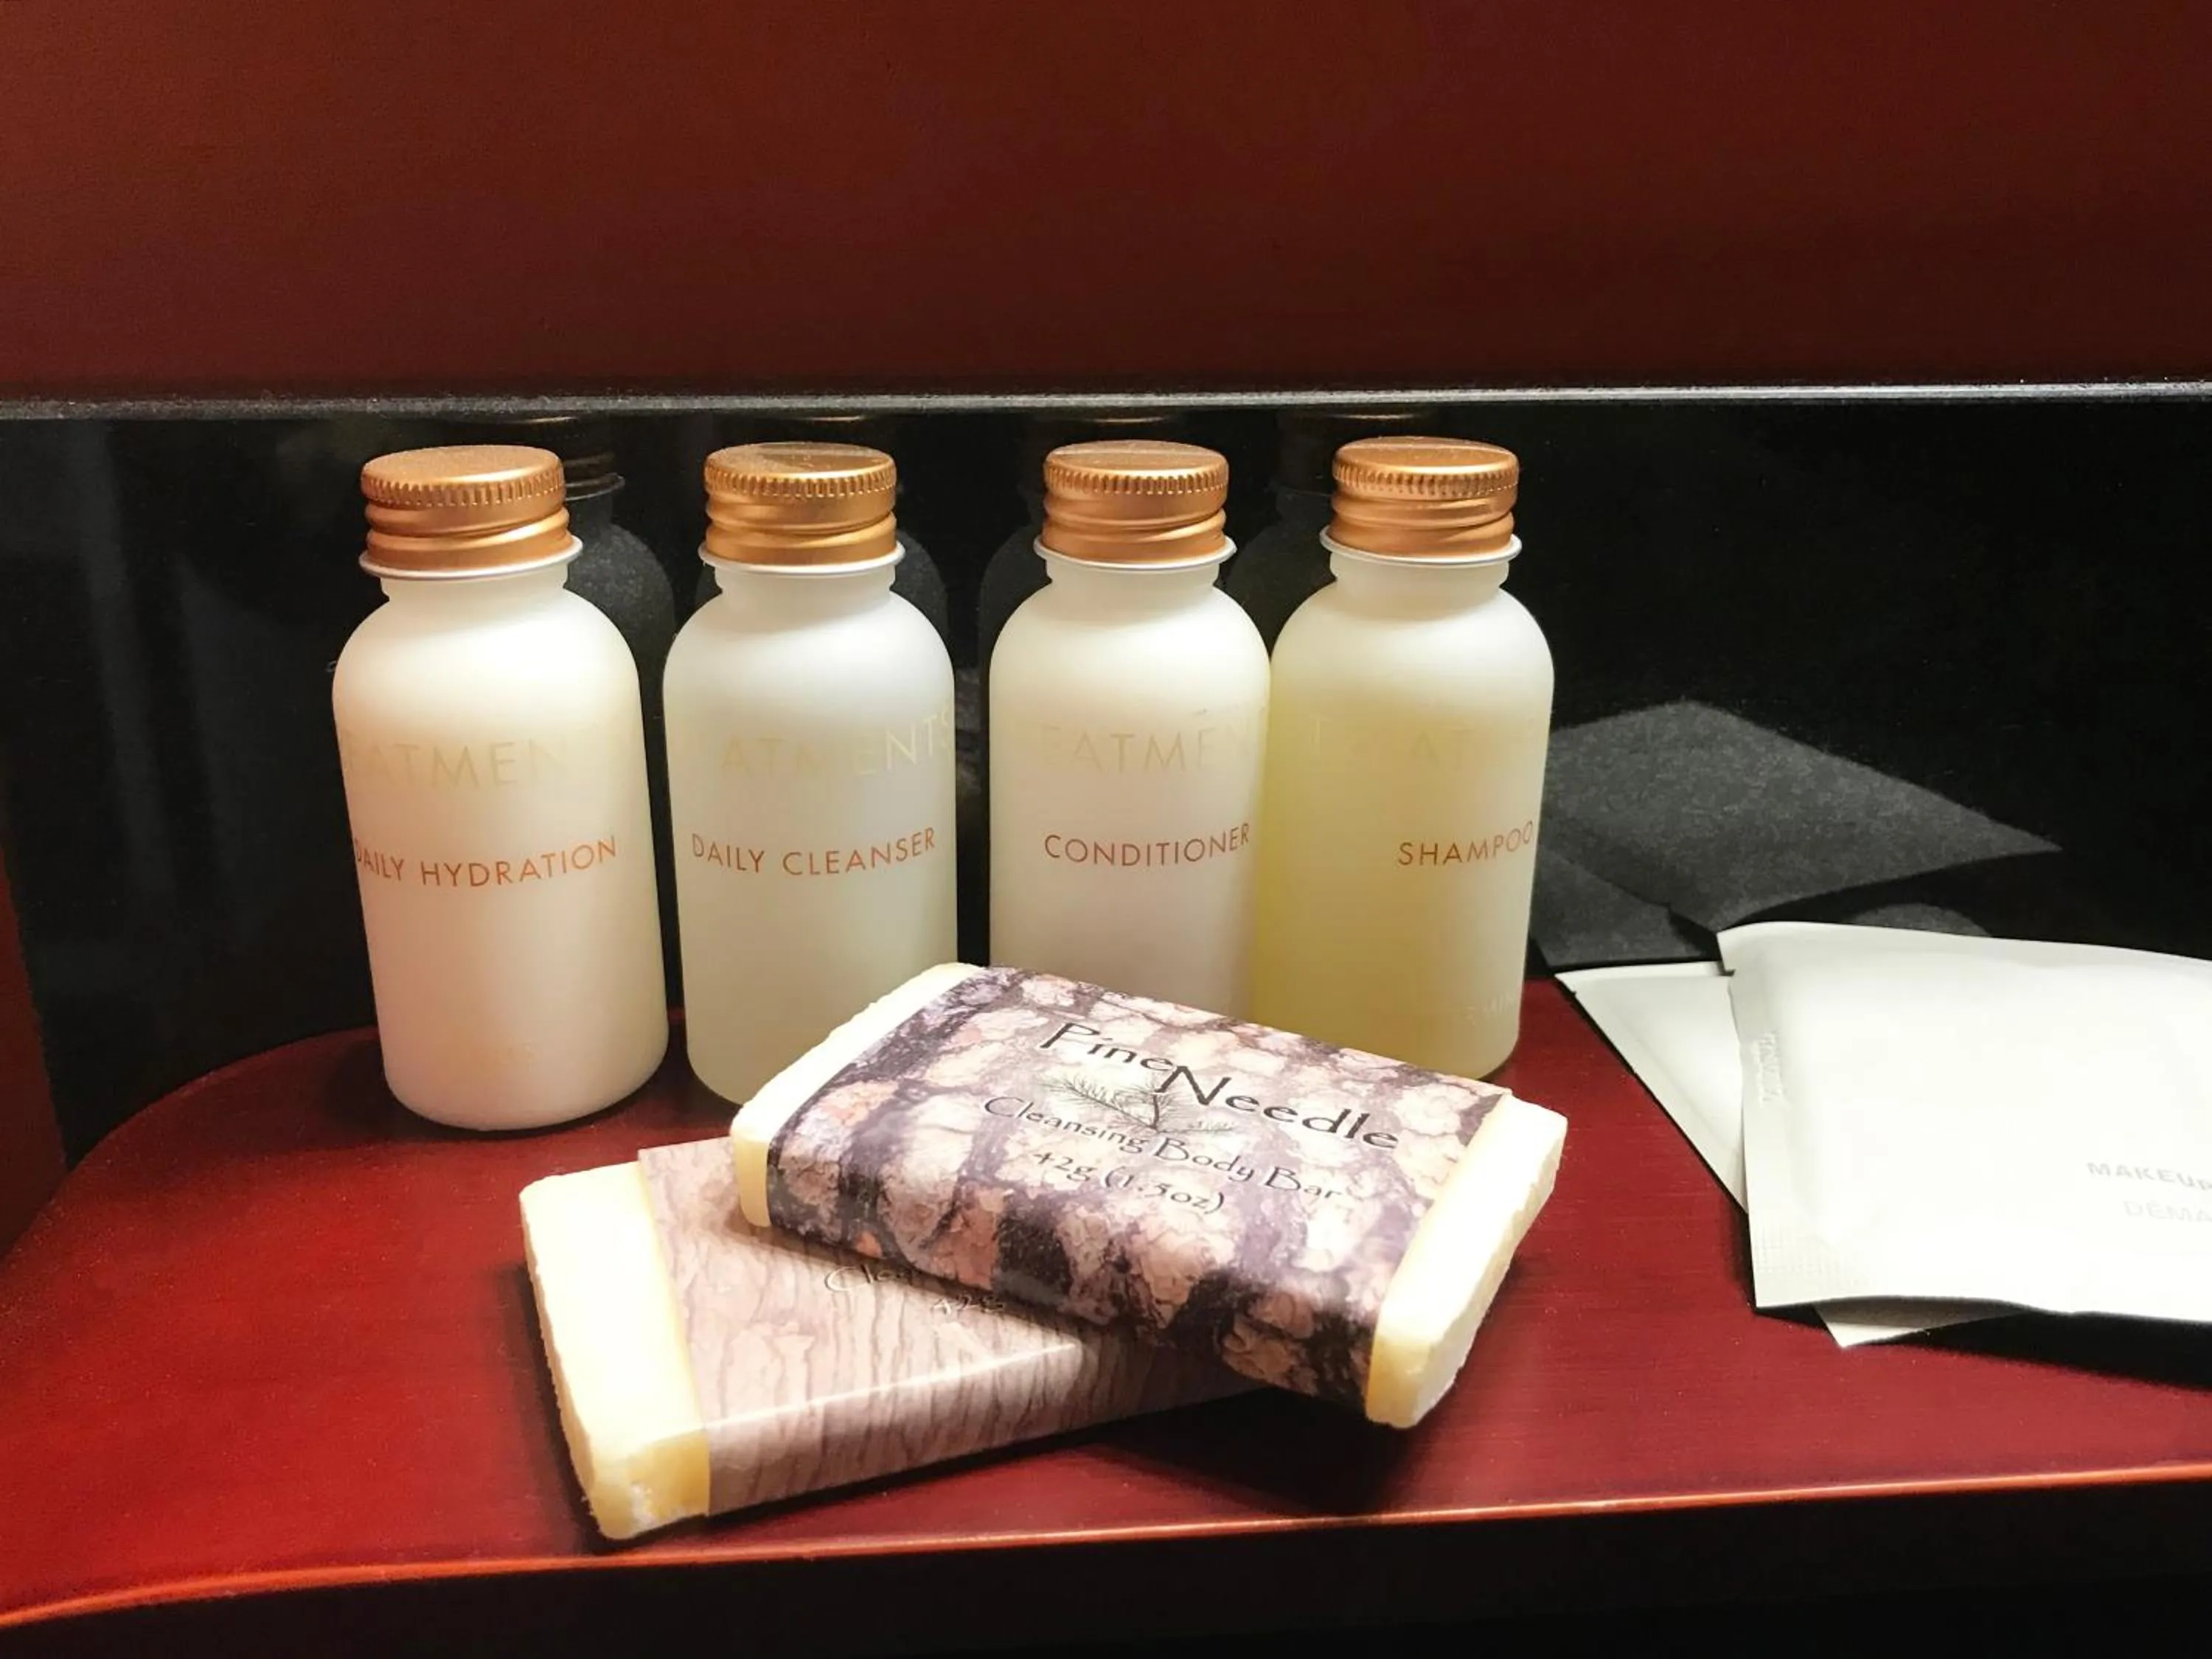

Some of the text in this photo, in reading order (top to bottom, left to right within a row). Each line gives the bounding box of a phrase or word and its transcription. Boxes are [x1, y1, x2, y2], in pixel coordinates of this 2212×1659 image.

[420, 835, 617, 887] HYDRATION
[691, 827, 936, 876] DAILY CLEANSER
[1043, 822, 1250, 866] CONDITIONER
[1397, 820, 1534, 866] SHAMPOO
[984, 1096, 1345, 1200] Cleansing Body Bar
[1032, 1151, 1096, 1183] 42g
